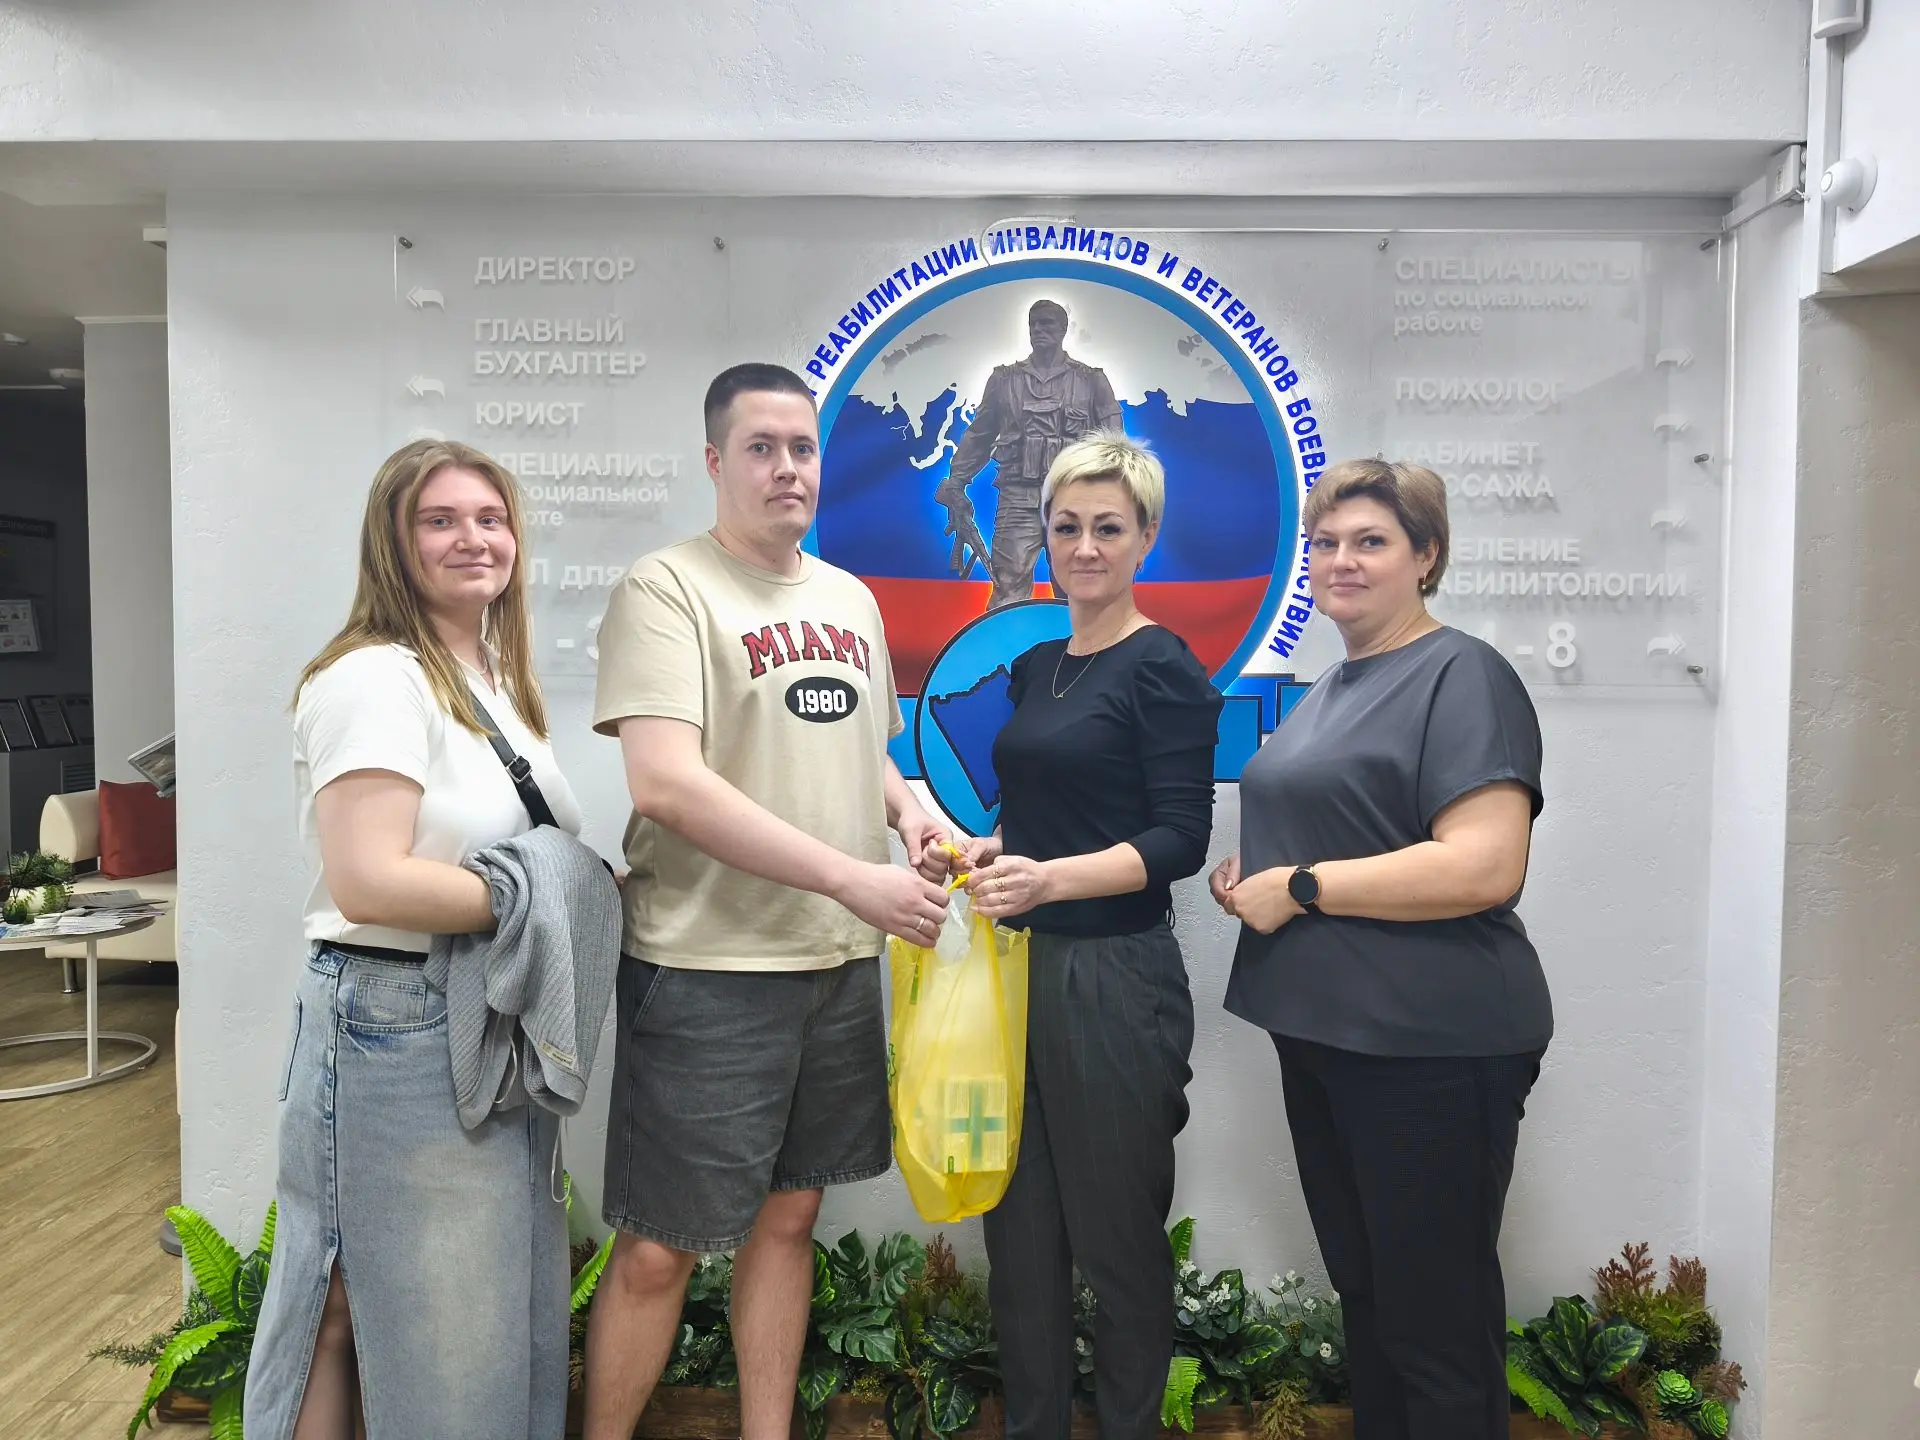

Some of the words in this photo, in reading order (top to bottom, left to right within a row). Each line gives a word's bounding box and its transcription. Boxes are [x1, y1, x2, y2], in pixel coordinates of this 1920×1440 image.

[475, 257, 635, 284] ДИРЕКТОР
[1395, 257, 1641, 284] СПЕЦИАЛИСТЫ
[1394, 290, 1426, 306] по
[475, 312, 625, 342] ГЛАВНЫЙ
[1394, 311, 1484, 336] работе
[475, 351, 647, 375] БУХГАЛТЕР
[806, 238, 978, 380] РЕАБИЛИТАЦИИ
[988, 226, 1149, 265] ИНВАЛИДОВ
[1157, 252, 1178, 278] И
[1181, 267, 1298, 392] ВЕТЕРАНОВ
[1286, 398, 1326, 493] БОЕВ
[1395, 376, 1564, 401] ПСИХОЛОГ
[476, 402, 585, 425] ЮРИСТ
[496, 452, 685, 480] ПЕЦИАЛИСТ
[1445, 473, 1555, 498] ССАЖА
[741, 621, 871, 680] MIAMI
[796, 689, 848, 714] 1980
